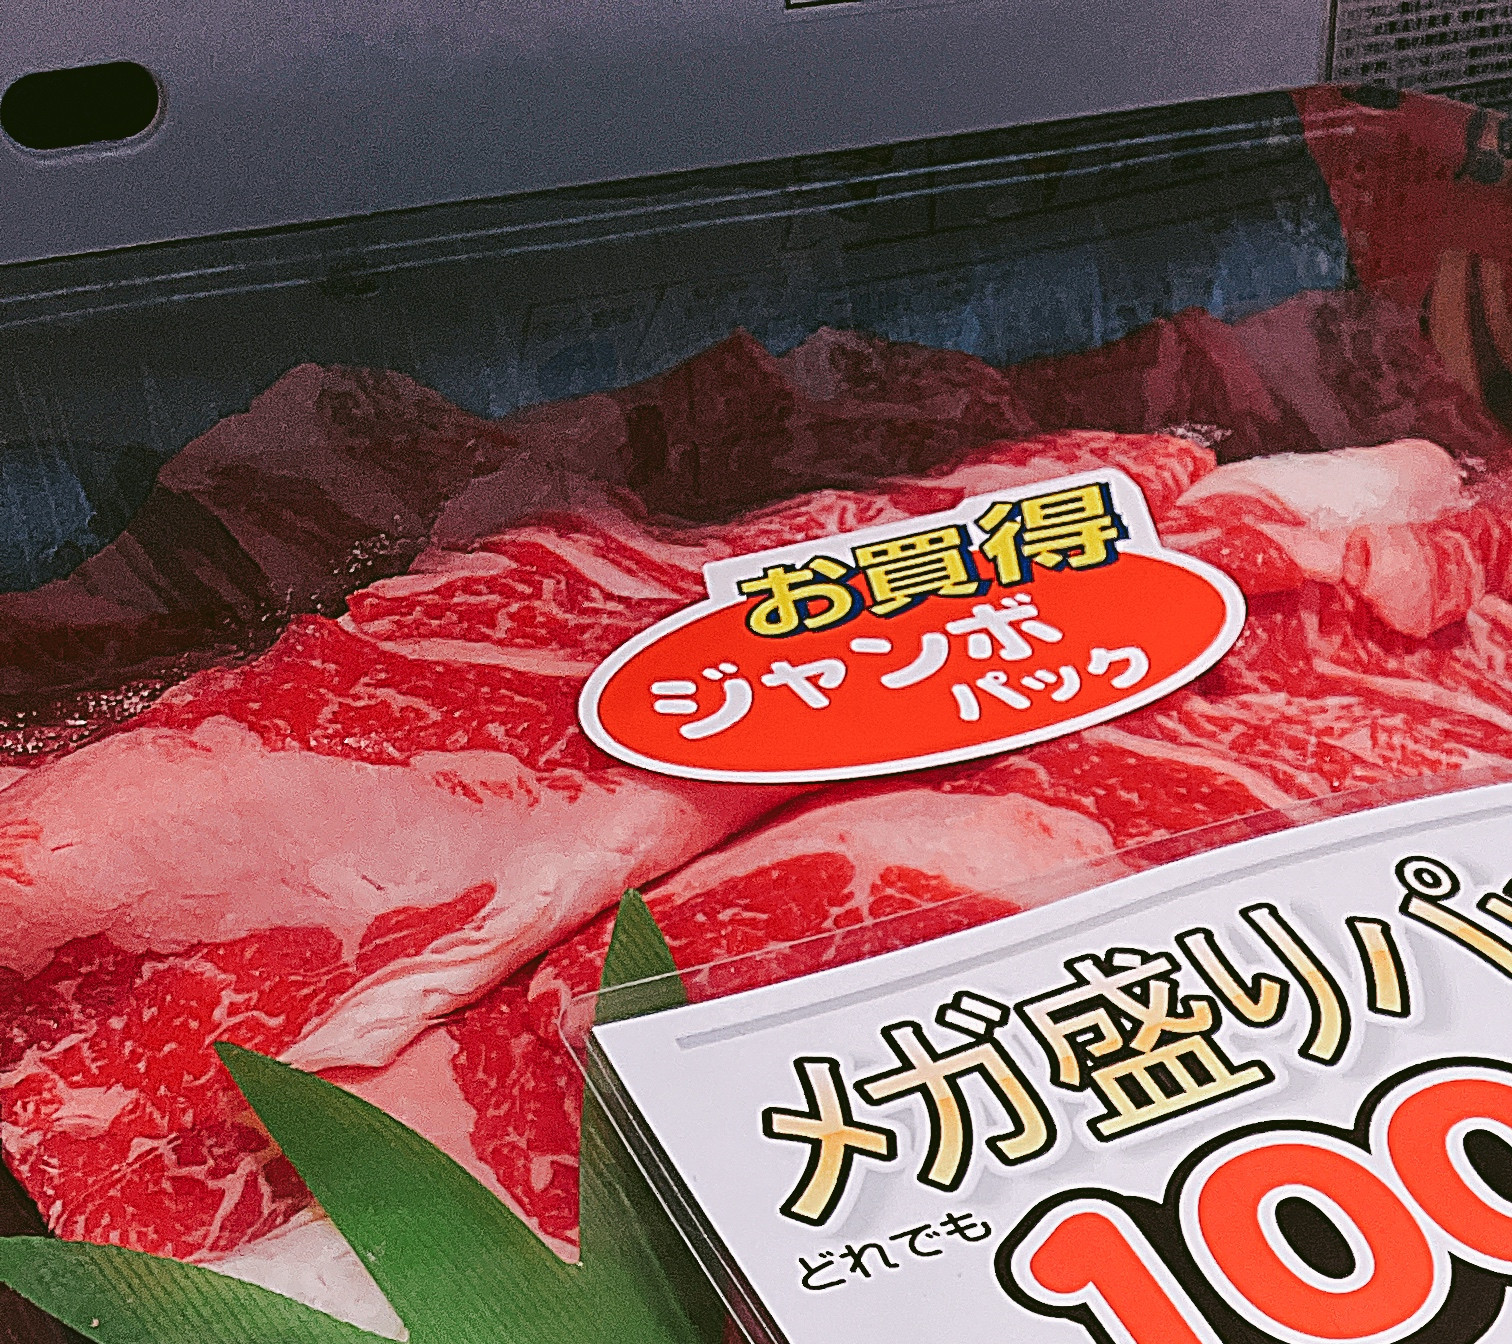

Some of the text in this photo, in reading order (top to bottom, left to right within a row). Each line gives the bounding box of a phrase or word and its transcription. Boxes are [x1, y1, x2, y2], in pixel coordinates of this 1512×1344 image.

[738, 481, 1127, 637] お買得
[650, 593, 1063, 739] ジャンボ
[952, 644, 1149, 722] パック
[798, 1211, 993, 1291] どれでも
